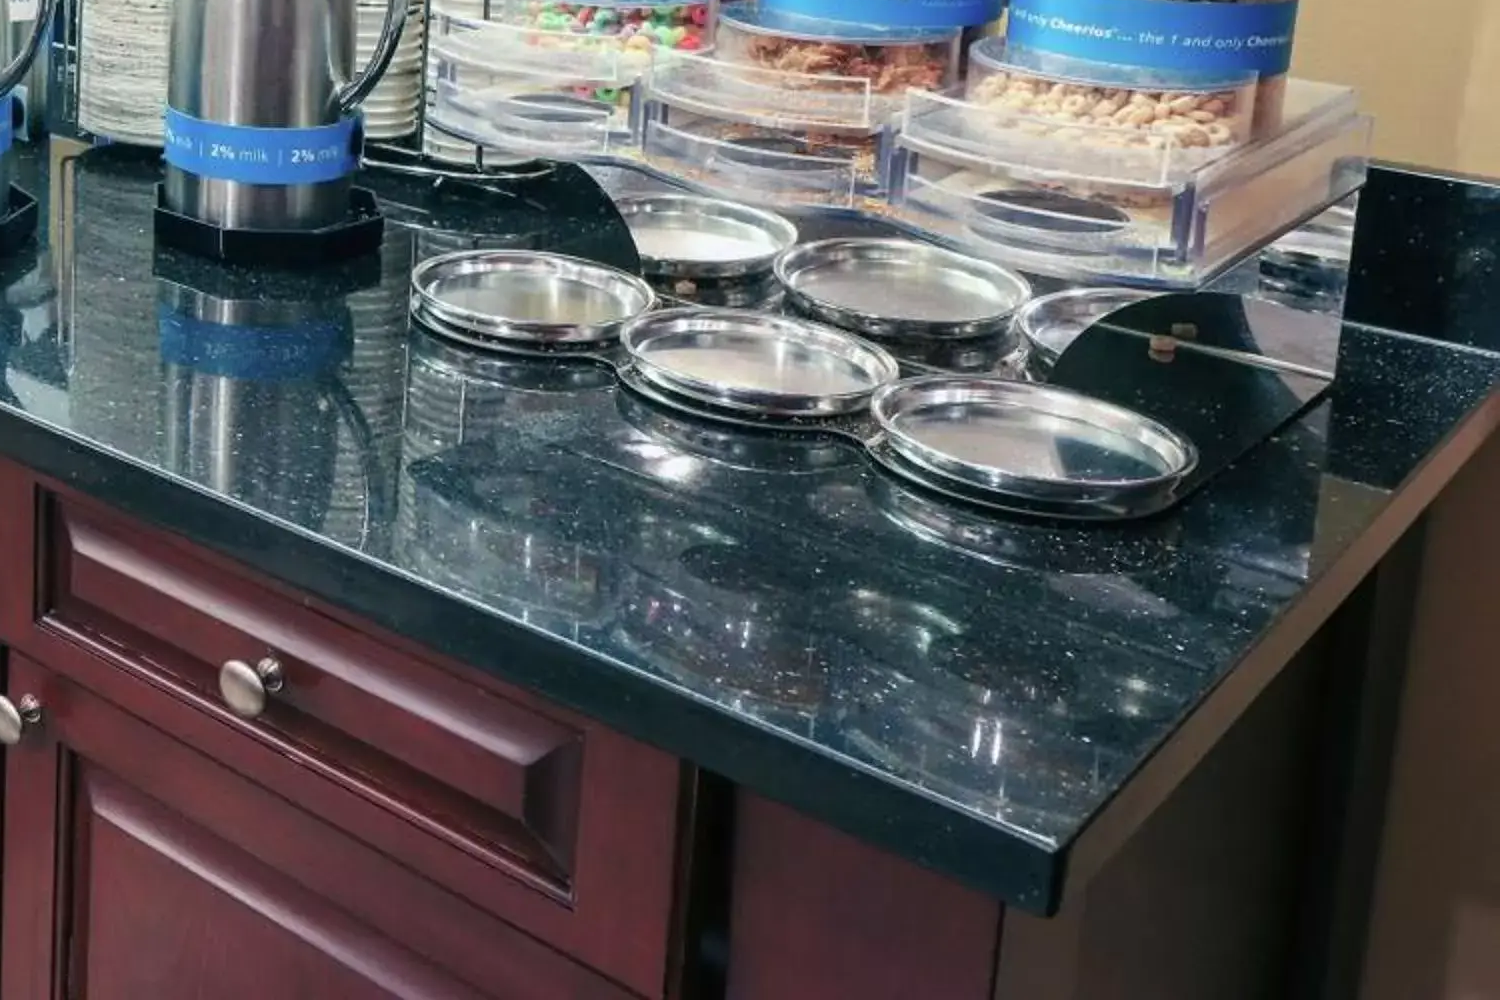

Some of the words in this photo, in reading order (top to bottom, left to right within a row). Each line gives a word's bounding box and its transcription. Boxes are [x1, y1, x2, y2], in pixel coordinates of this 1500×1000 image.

[1138, 31, 1164, 46] the
[1183, 33, 1212, 48] and
[1214, 36, 1243, 52] only
[211, 142, 236, 161] 2%
[238, 145, 270, 164] milk
[291, 148, 316, 165] 2%
